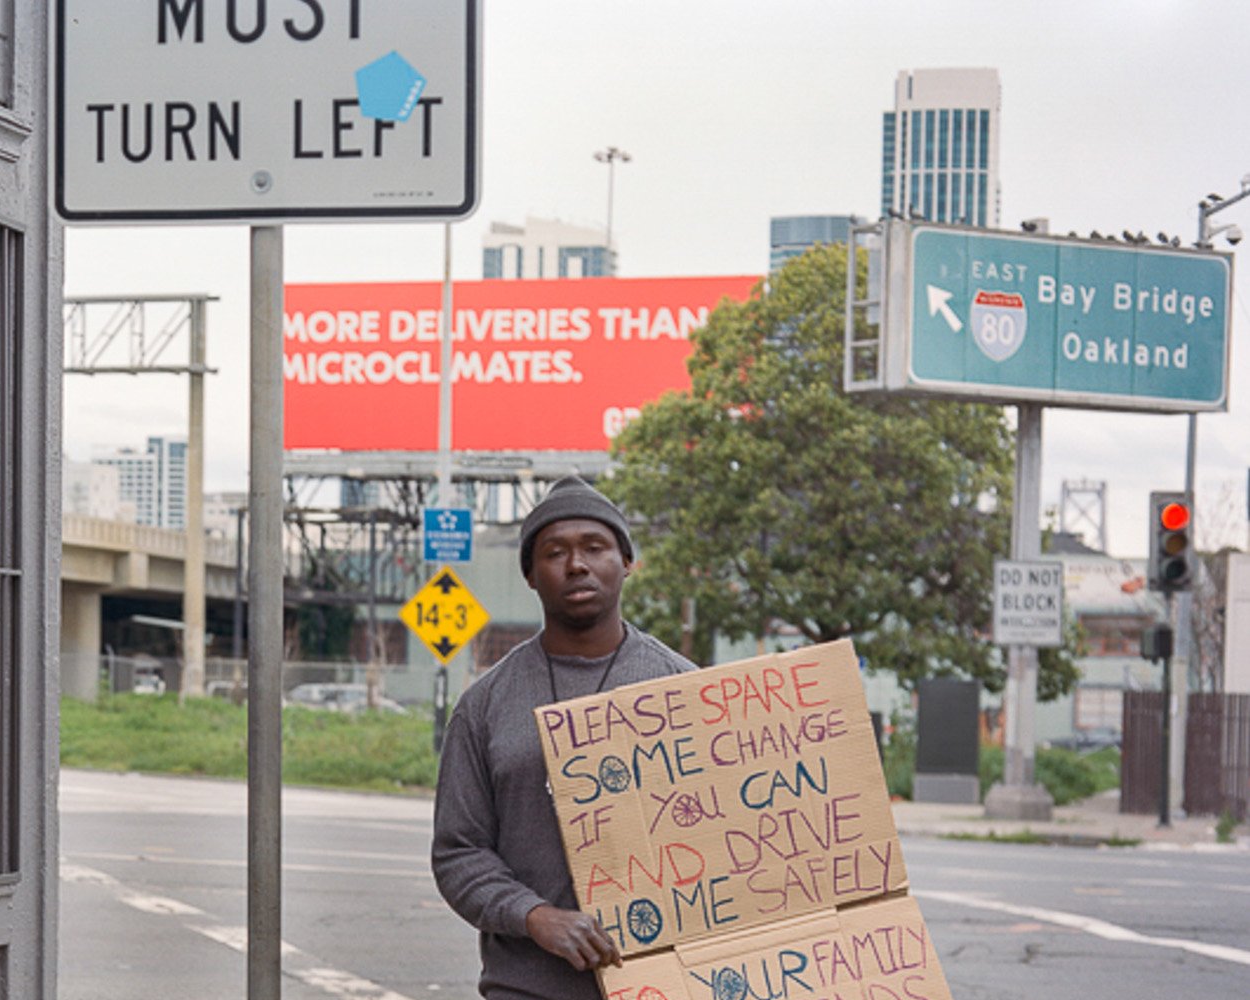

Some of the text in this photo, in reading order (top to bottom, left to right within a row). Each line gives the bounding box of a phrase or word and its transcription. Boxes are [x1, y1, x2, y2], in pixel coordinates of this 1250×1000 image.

[87, 101, 241, 163] TURN
[293, 97, 443, 159] LEFT
[972, 260, 1027, 282] EAST
[1038, 274, 1214, 324] Bay Bridge
[283, 310, 380, 343] MORE
[598, 306, 709, 341] THAN
[981, 312, 1015, 346] 80
[1062, 332, 1188, 369] Oakland
[283, 350, 583, 384] MICROCLMATES.
[1000, 569, 1022, 586] DO
[1028, 570, 1059, 587] NOT
[543, 661, 830, 758] PLEASE SPARE
[561, 708, 848, 804] SOME CHANGE
[569, 756, 828, 852] IF YOU CAN
[586, 793, 863, 905] AND DRIVE
[597, 841, 892, 945] HOME SAFELY
[812, 922, 929, 988] FAMILY
